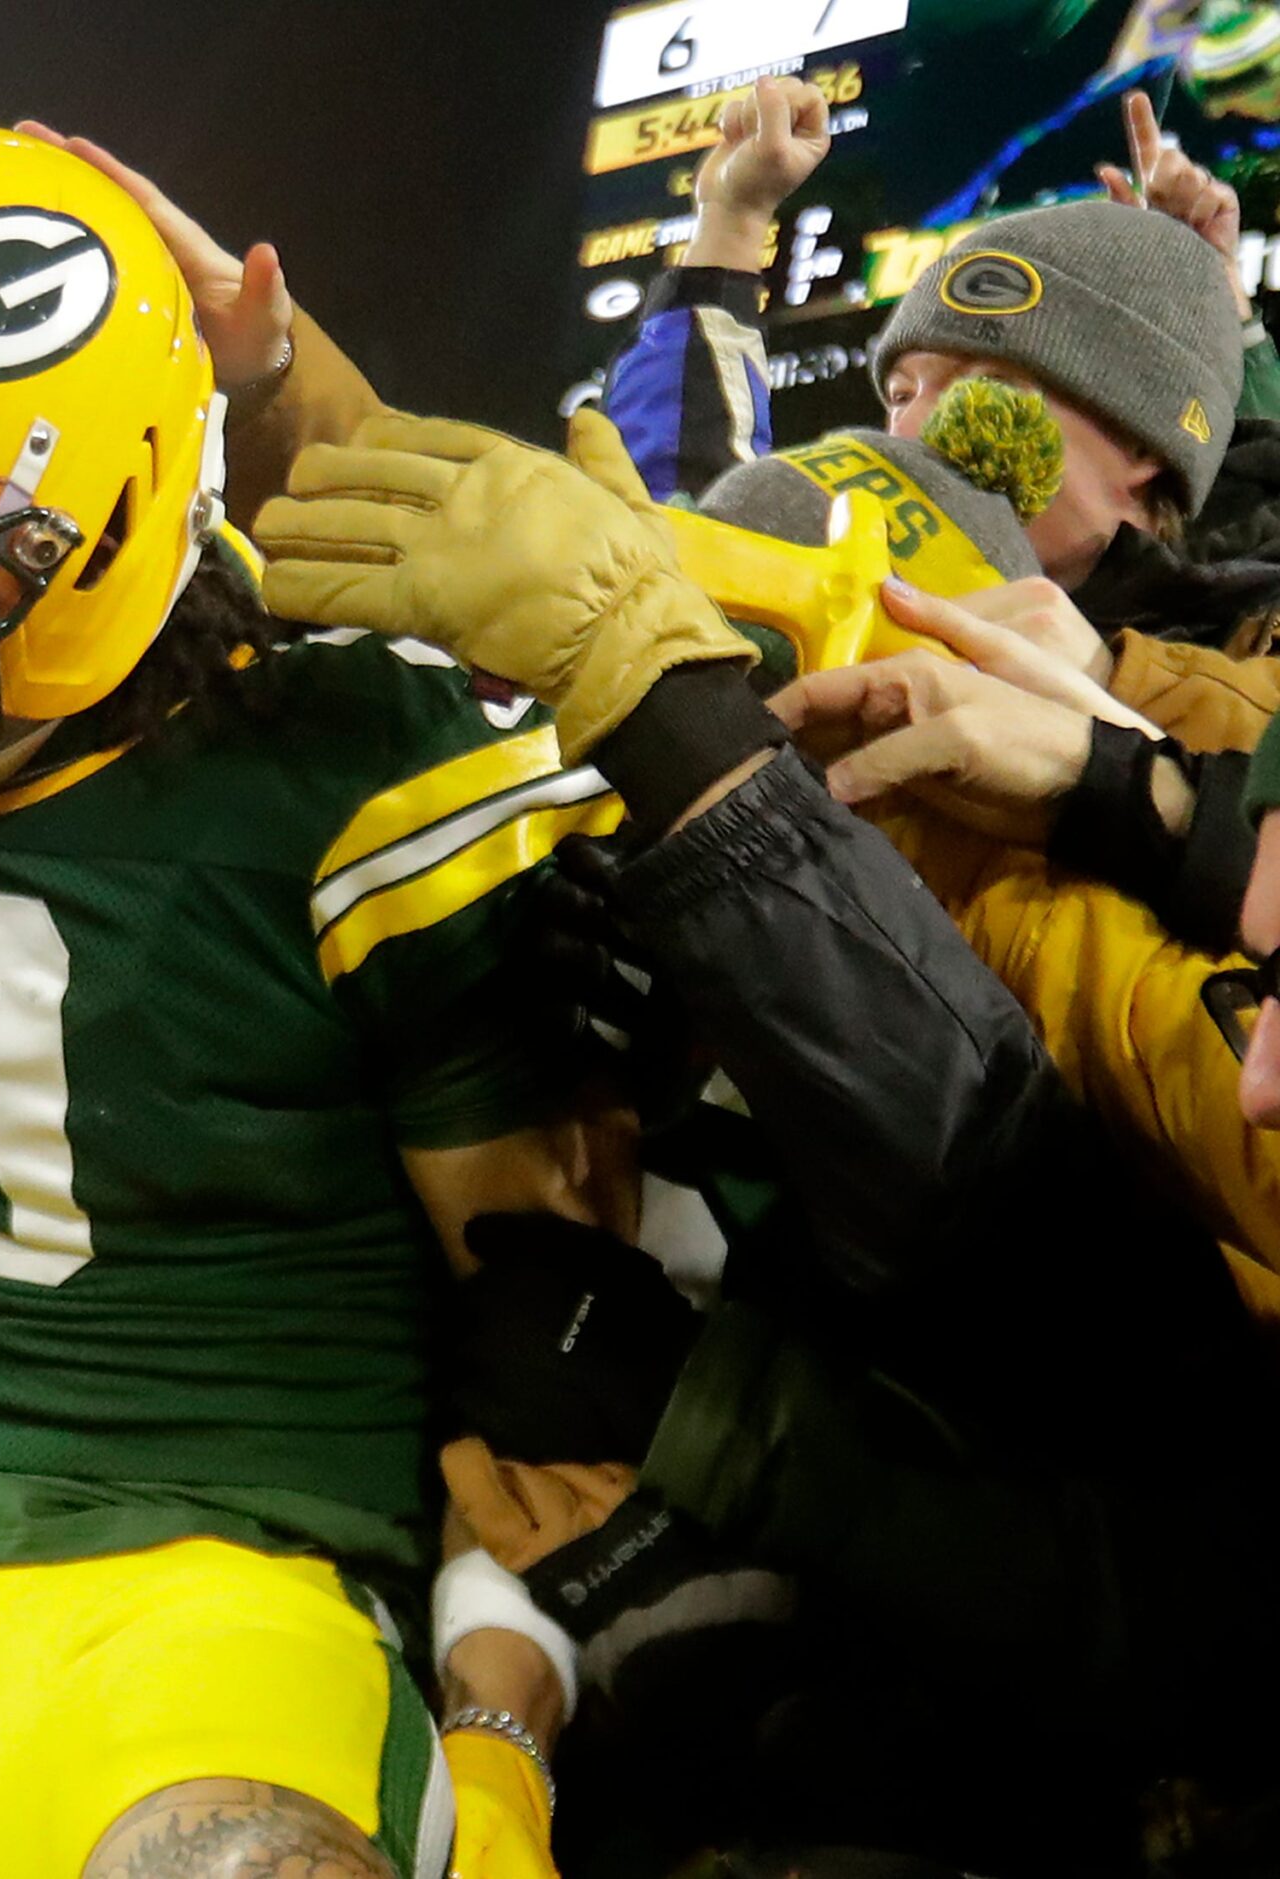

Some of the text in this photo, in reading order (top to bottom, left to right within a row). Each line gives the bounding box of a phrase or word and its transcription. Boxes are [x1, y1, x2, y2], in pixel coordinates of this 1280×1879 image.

[658, 16, 698, 77] 6
[690, 56, 806, 99] 1ST QUARTER
[580, 219, 658, 267] GAME
